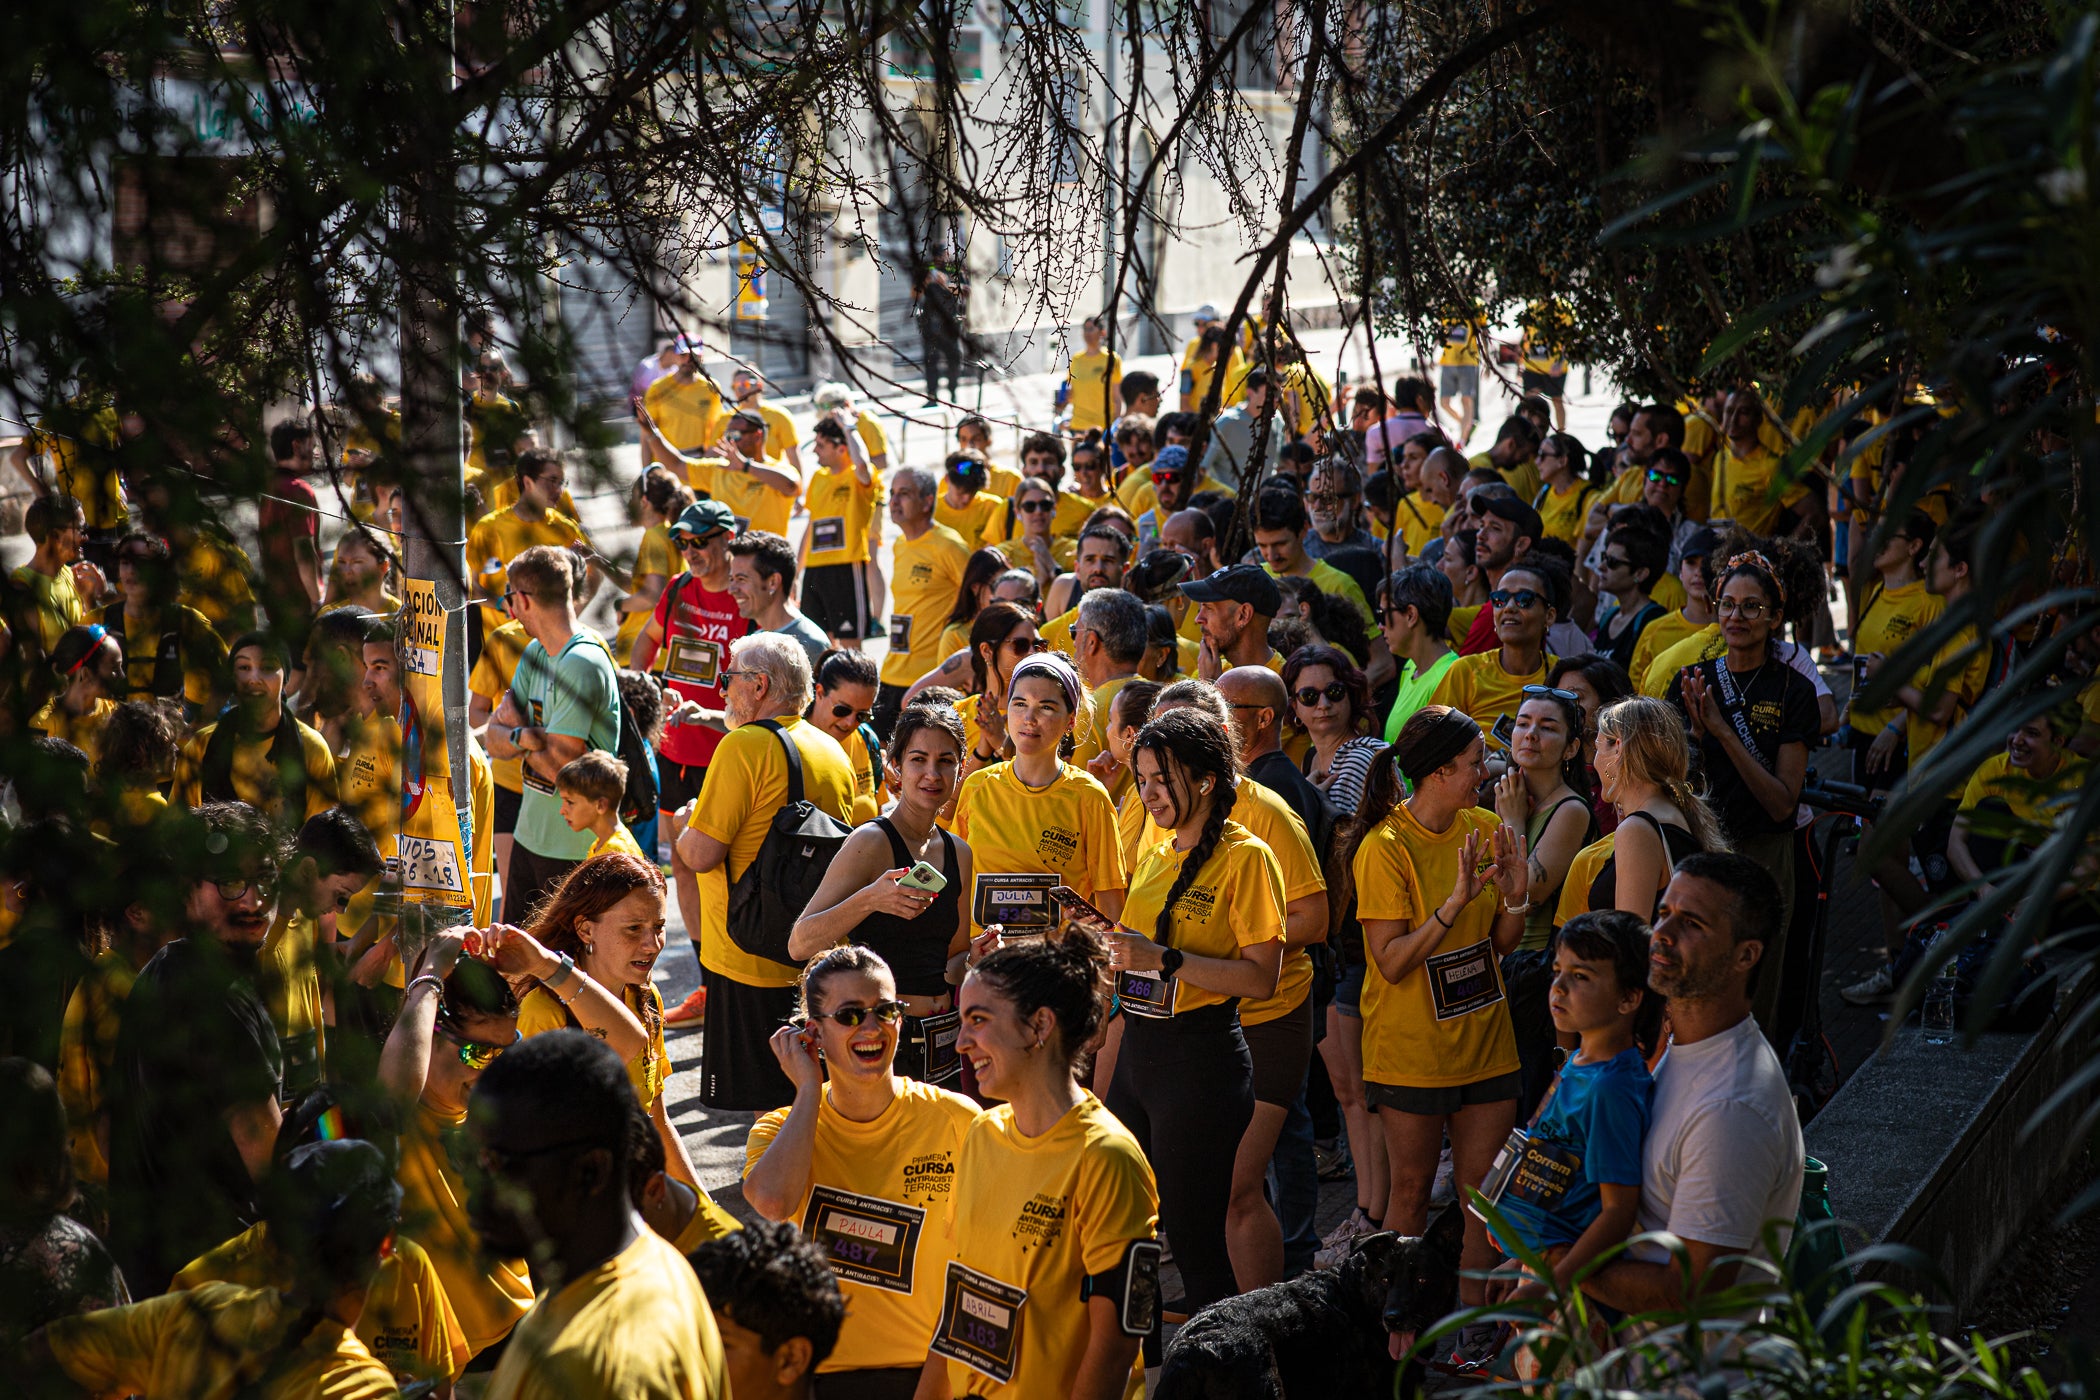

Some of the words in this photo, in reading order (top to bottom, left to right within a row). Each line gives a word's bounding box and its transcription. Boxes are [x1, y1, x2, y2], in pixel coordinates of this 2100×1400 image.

[1752, 704, 1780, 717] CURSA
[1042, 830, 1077, 848] CURSA
[1051, 825, 1075, 838] PRIMERA
[1039, 843, 1072, 861] TERRASSA
[1127, 979, 1151, 997] 266
[912, 1154, 947, 1164] PRIMERA
[1526, 1149, 1571, 1176] Correm
[903, 1162, 955, 1176] CURSA
[903, 1183, 950, 1193] TERRASS
[1023, 1200, 1065, 1219] CURSA
[839, 1218, 884, 1240] PAULA
[834, 1239, 878, 1264] 487
[967, 1321, 996, 1349] 163
